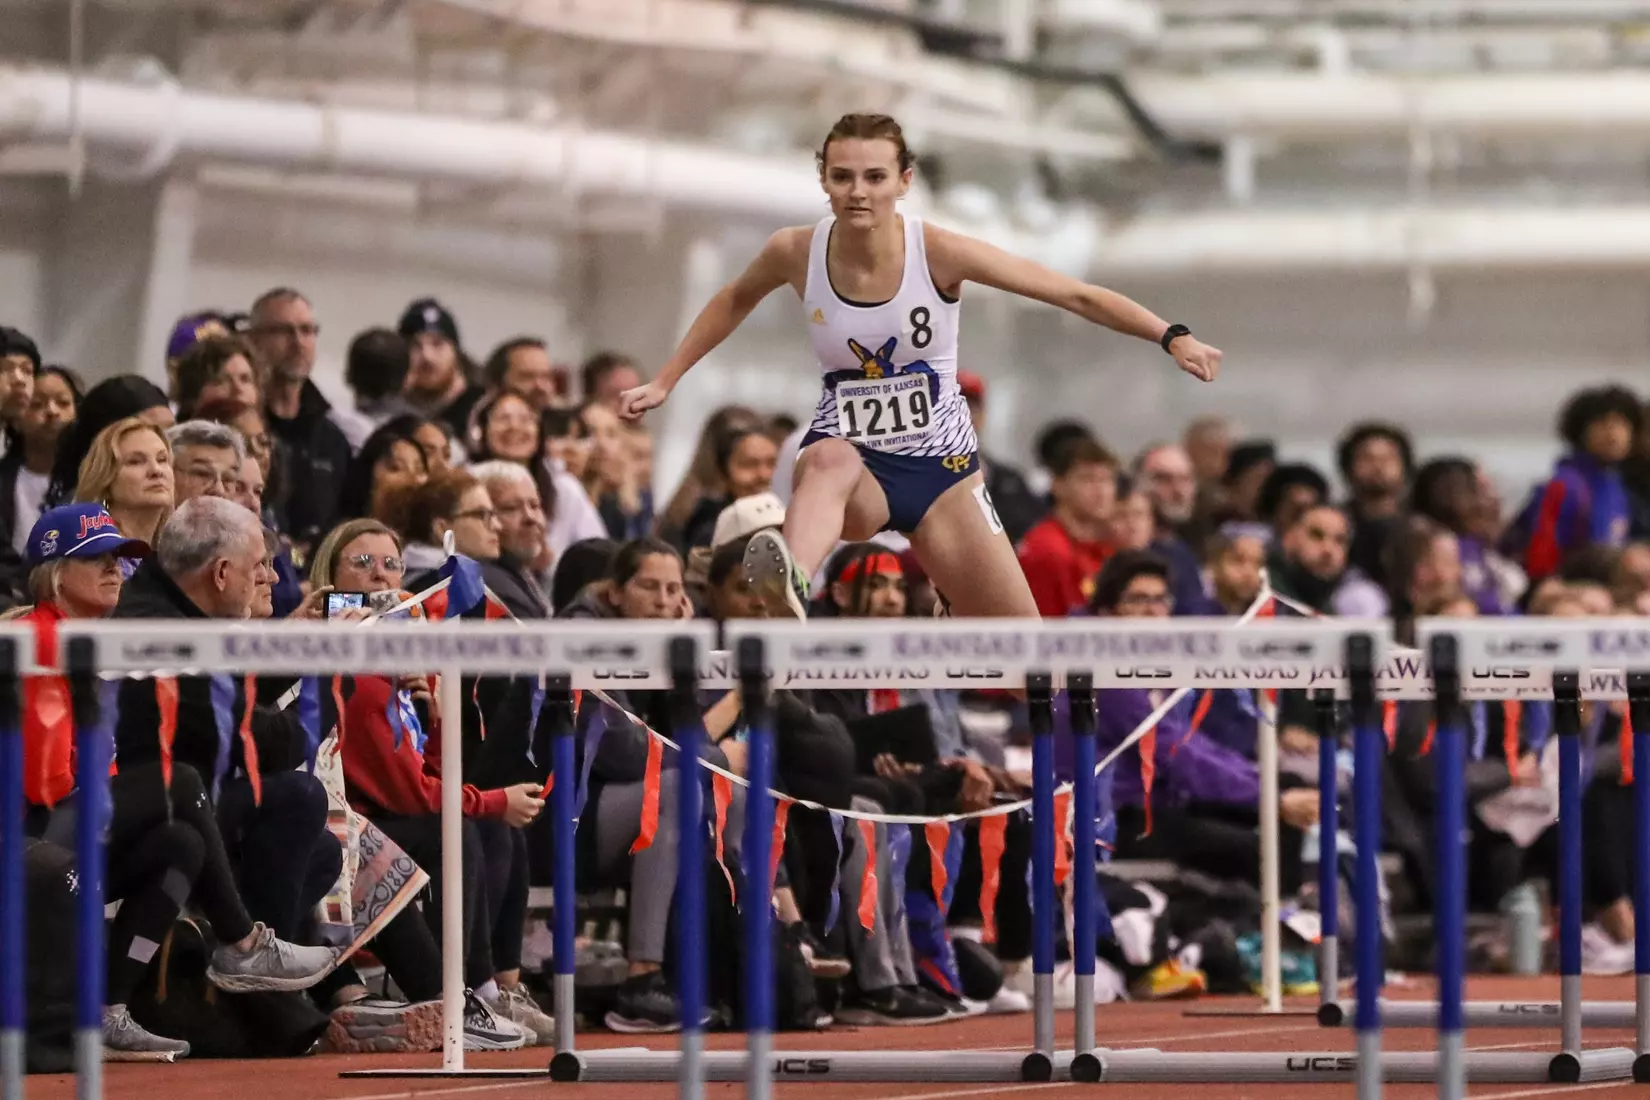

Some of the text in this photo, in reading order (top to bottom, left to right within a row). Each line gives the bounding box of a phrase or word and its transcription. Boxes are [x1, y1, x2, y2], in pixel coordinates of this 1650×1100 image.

[909, 306, 932, 349] 8
[840, 379, 924, 397] UNIVERSITY OF KANSAS
[842, 390, 930, 437] 1219
[1498, 1003, 1560, 1015] UCS
[1286, 1058, 1358, 1071] UCS
